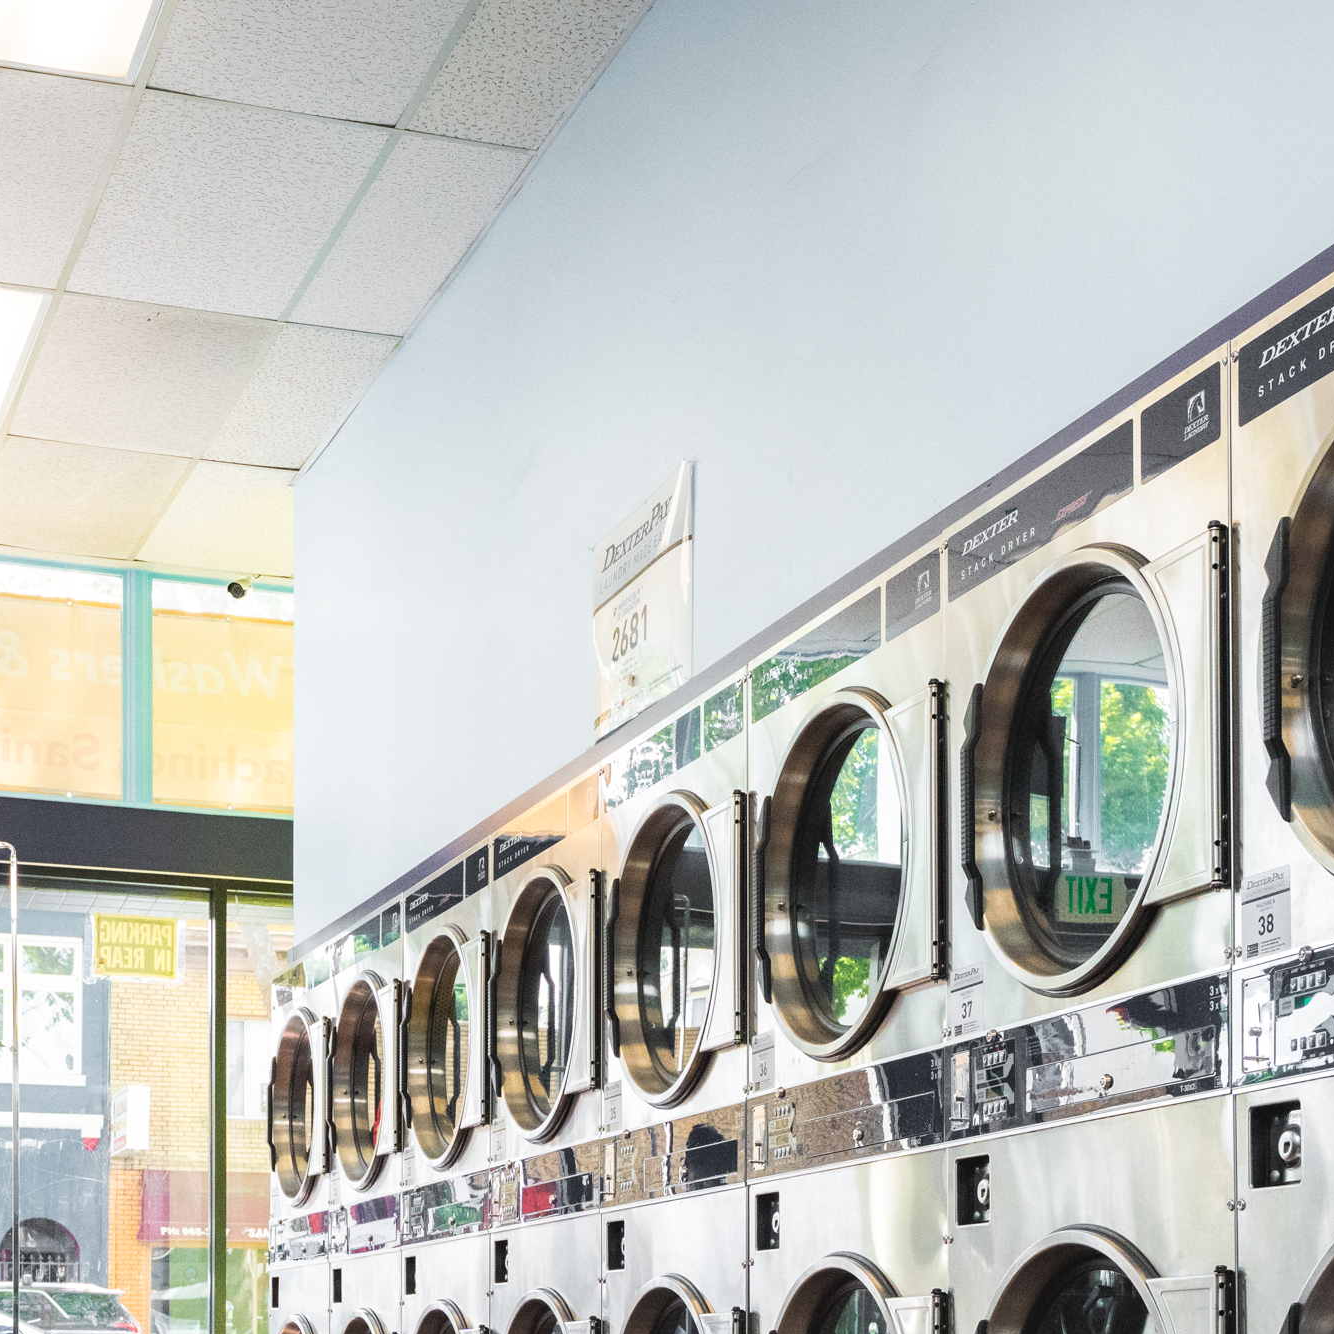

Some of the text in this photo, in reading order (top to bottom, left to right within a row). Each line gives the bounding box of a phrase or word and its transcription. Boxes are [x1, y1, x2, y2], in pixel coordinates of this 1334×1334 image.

[1258, 358, 1307, 397] STACK
[1184, 414, 1209, 435] DEXTER
[961, 510, 1019, 556] DEXTER
[961, 527, 1035, 580] STACK DRYER
[611, 604, 647, 662] 2681
[1258, 913, 1274, 936] 38
[1209, 985, 1214, 996] 3
[962, 1000, 972, 1019] 37
[1209, 1000, 1214, 1011] 3
[759, 1061, 768, 1077] 36
